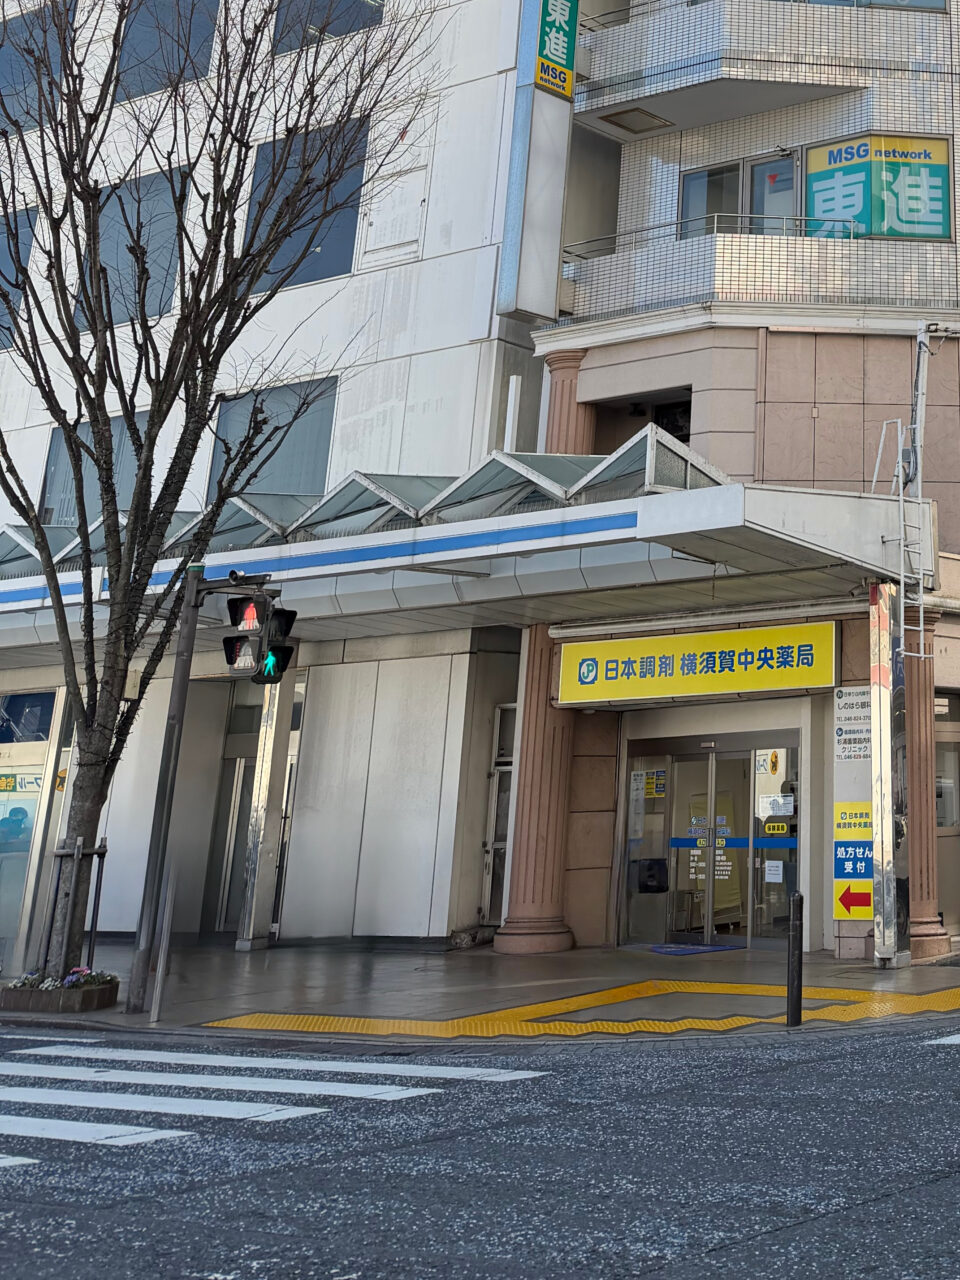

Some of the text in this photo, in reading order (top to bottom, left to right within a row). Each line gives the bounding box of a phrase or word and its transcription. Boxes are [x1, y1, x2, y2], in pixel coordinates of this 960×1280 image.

[540, 61, 567, 83] MSG
[540, 76, 567, 92] network
[828, 143, 933, 165] MSG network
[812, 166, 943, 238] 東進
[605, 654, 674, 681] 日本調剤
[680, 644, 814, 676] 横須賀中央薬局
[836, 846, 873, 859] 処方せん
[844, 861, 866, 873] 受付
